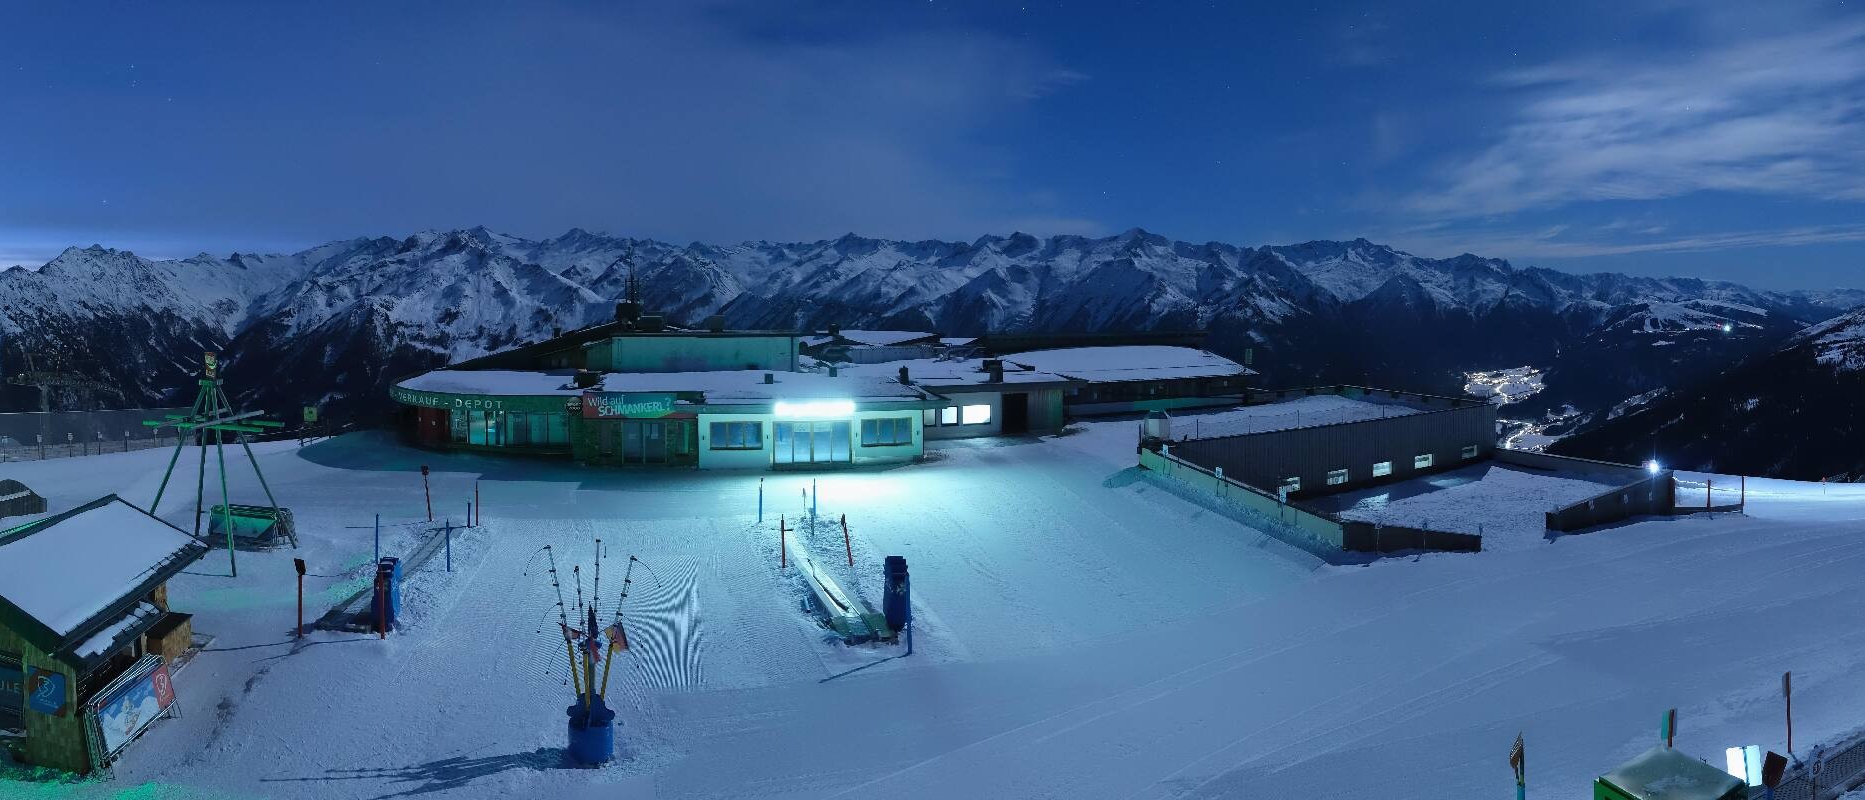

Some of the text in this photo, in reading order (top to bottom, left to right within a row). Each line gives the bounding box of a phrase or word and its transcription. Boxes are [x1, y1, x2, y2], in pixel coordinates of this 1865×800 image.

[455, 398, 503, 409] DEPOT
[587, 395, 626, 407] Wild auf
